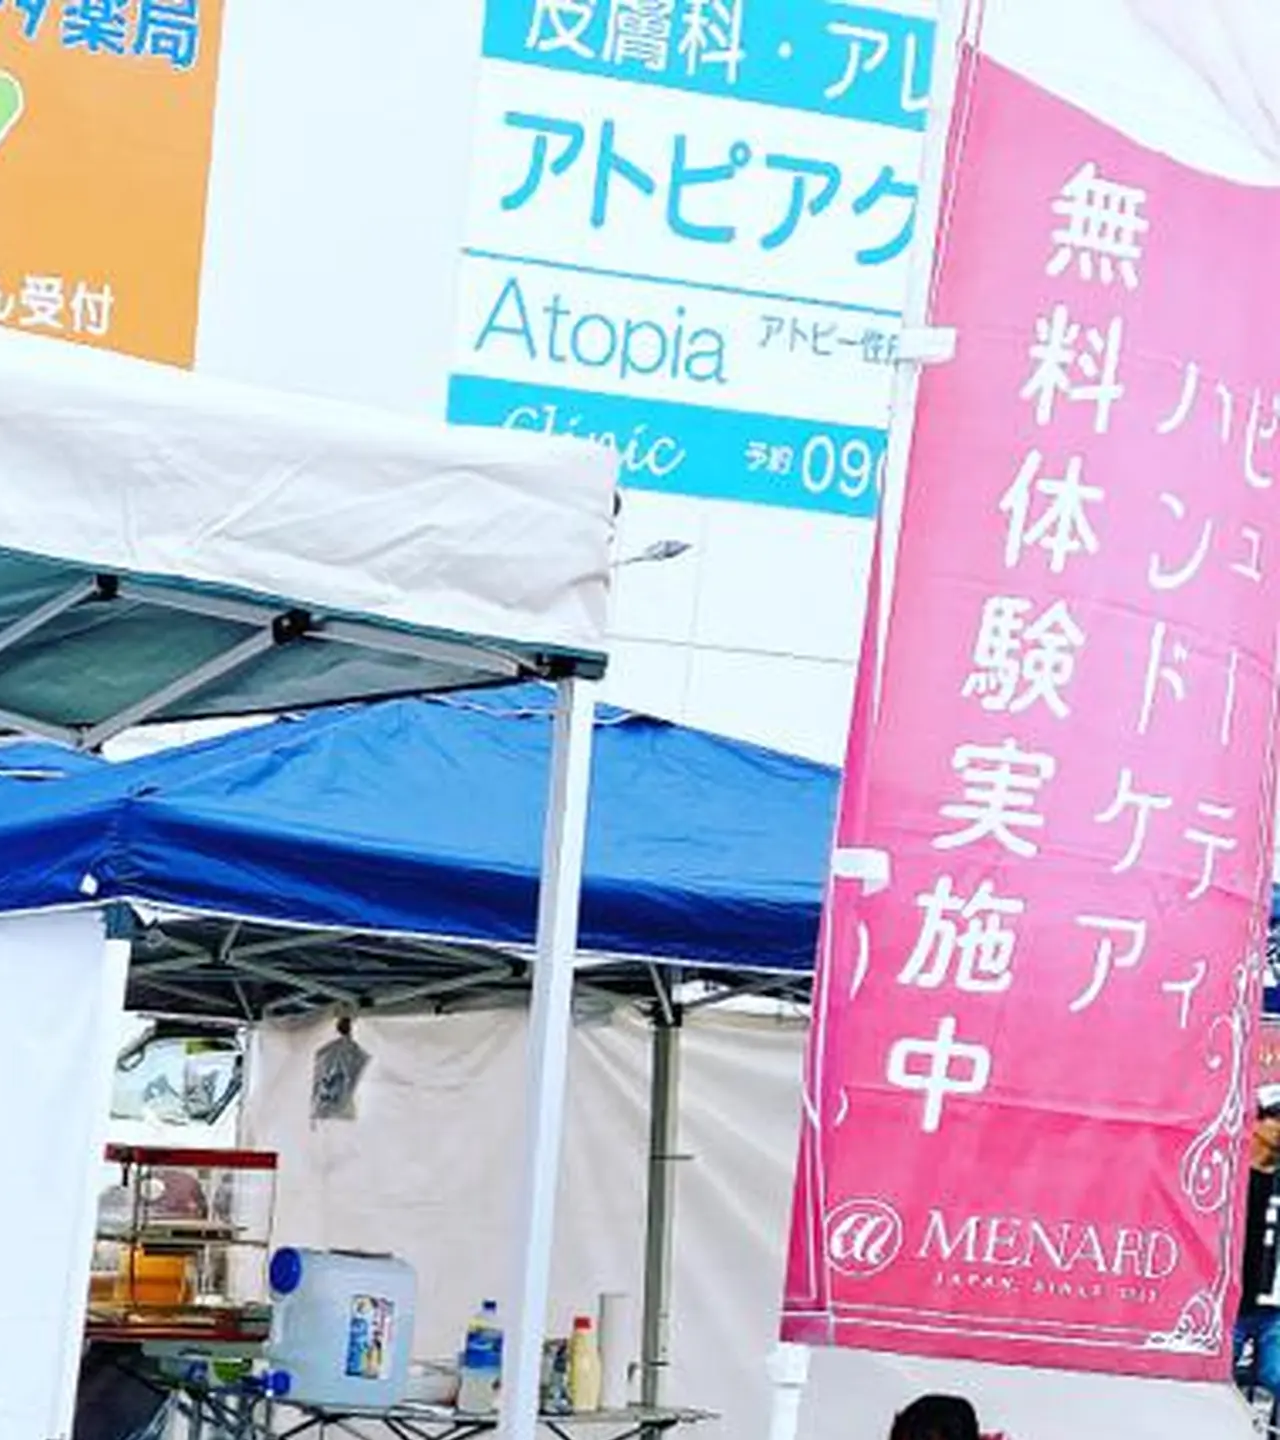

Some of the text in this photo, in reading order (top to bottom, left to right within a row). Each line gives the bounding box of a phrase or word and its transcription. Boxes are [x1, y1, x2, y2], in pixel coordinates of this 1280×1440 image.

[501, 110, 919, 265] アトピアク
[473, 277, 728, 384] Atopia
[884, 161, 1151, 1133] 無料体験実施中
[1069, 360, 1233, 1014] ハンドケア
[916, 1208, 1181, 1279] MENARD
